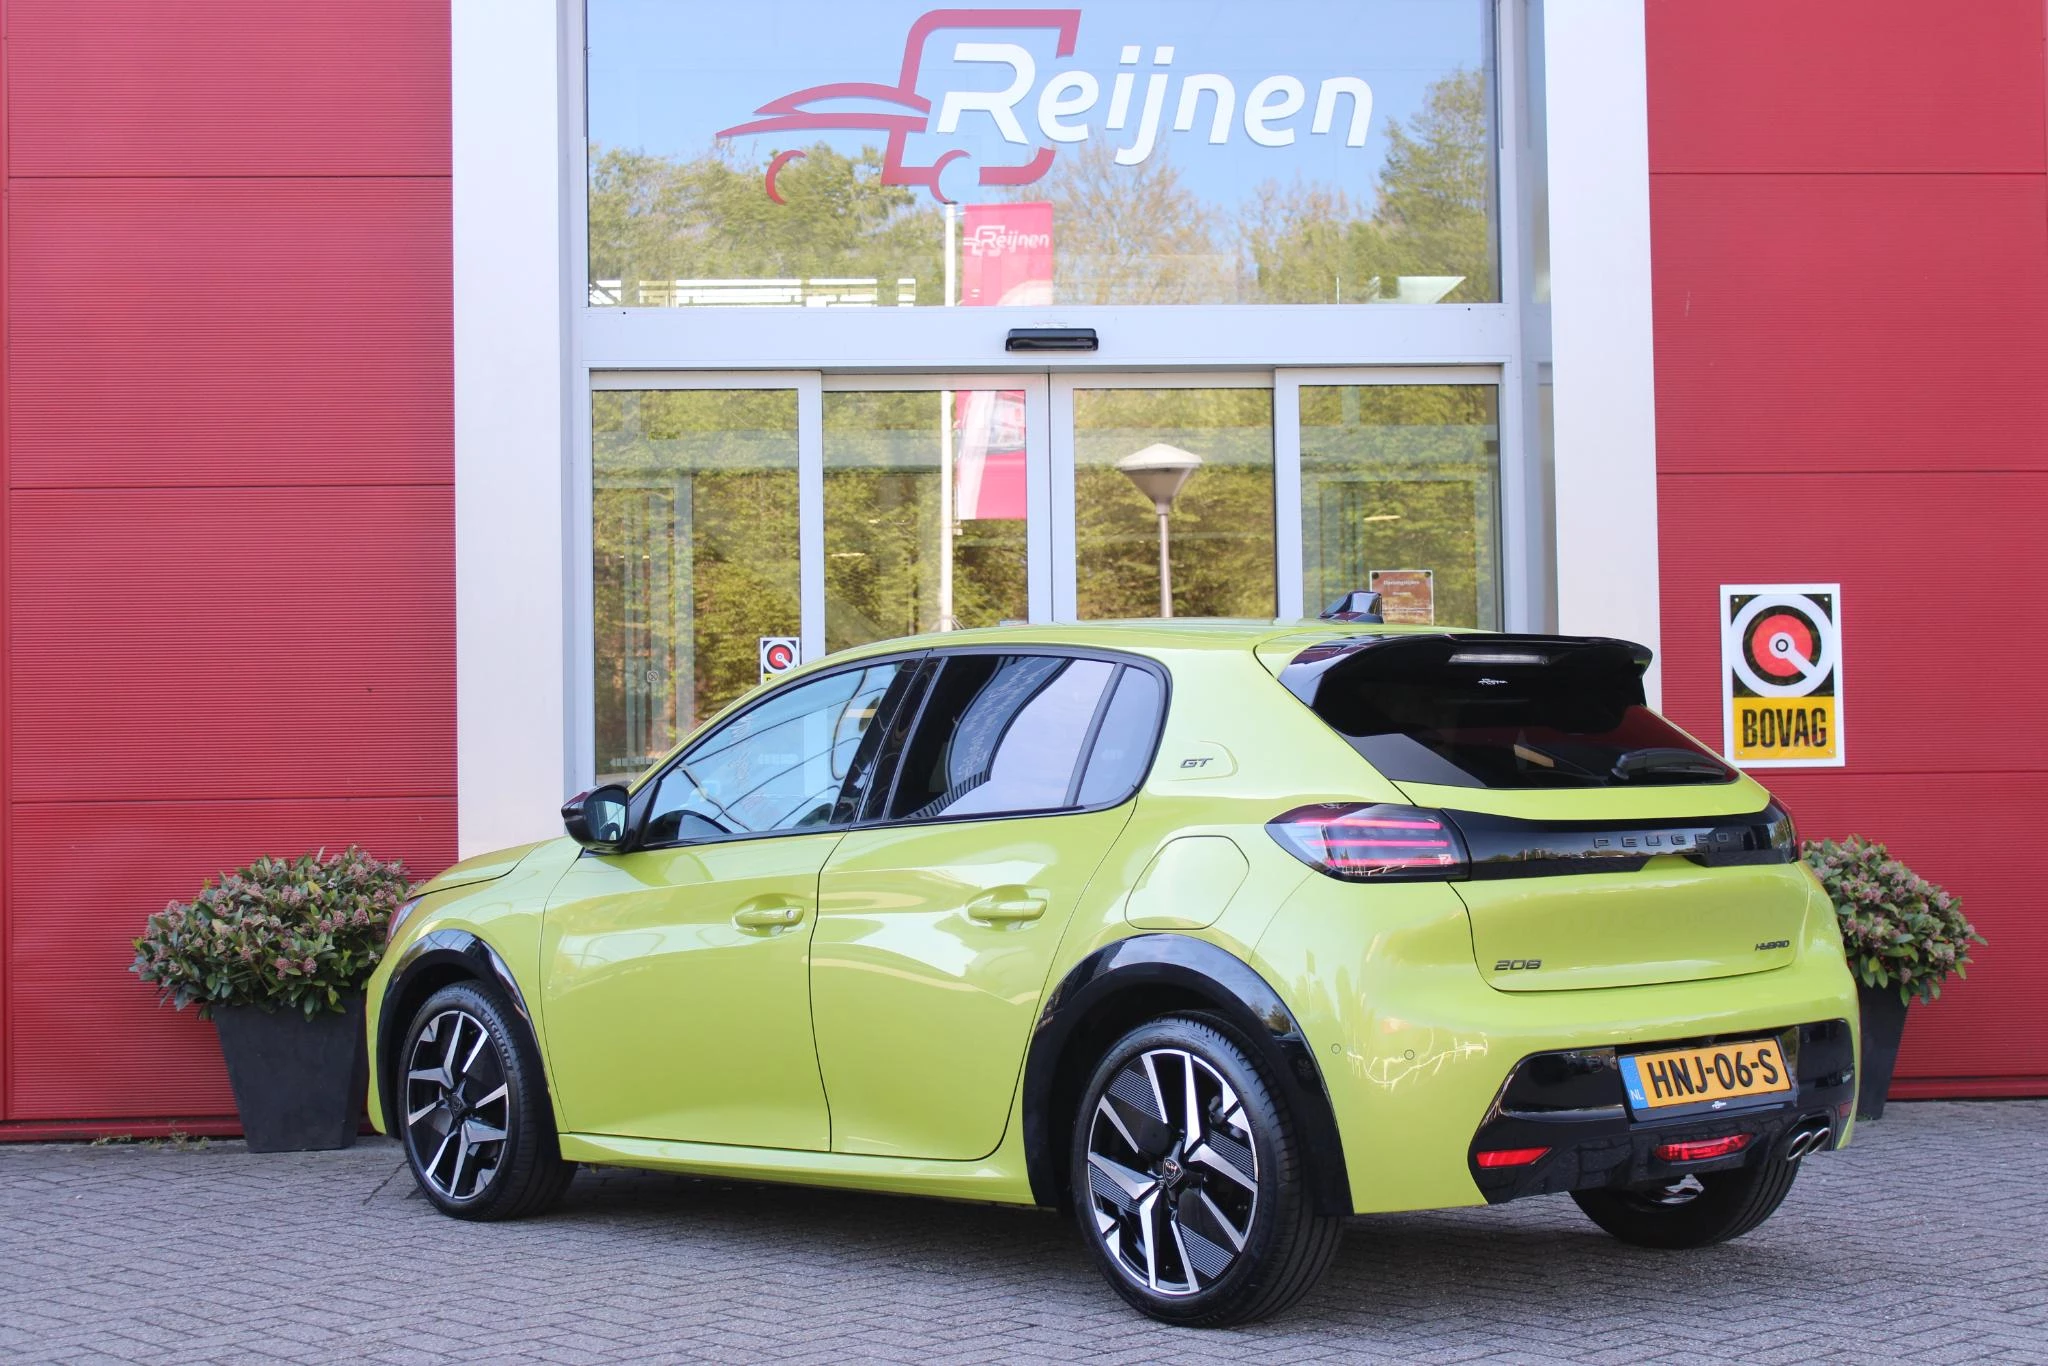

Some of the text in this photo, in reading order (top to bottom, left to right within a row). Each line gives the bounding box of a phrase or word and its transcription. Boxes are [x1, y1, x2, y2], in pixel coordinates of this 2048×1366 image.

[936, 43, 1374, 166] Reijnen
[980, 231, 1050, 253] Reijnen
[1742, 708, 1827, 748] BOVAG
[1180, 758, 1214, 768] GT
[1754, 940, 1790, 951] HYBRID
[1494, 959, 1542, 971] 208
[482, 1011, 513, 1068] MICHELIN
[1646, 1049, 1779, 1099] HNJ-06-S
[1629, 1089, 1645, 1101] NL
